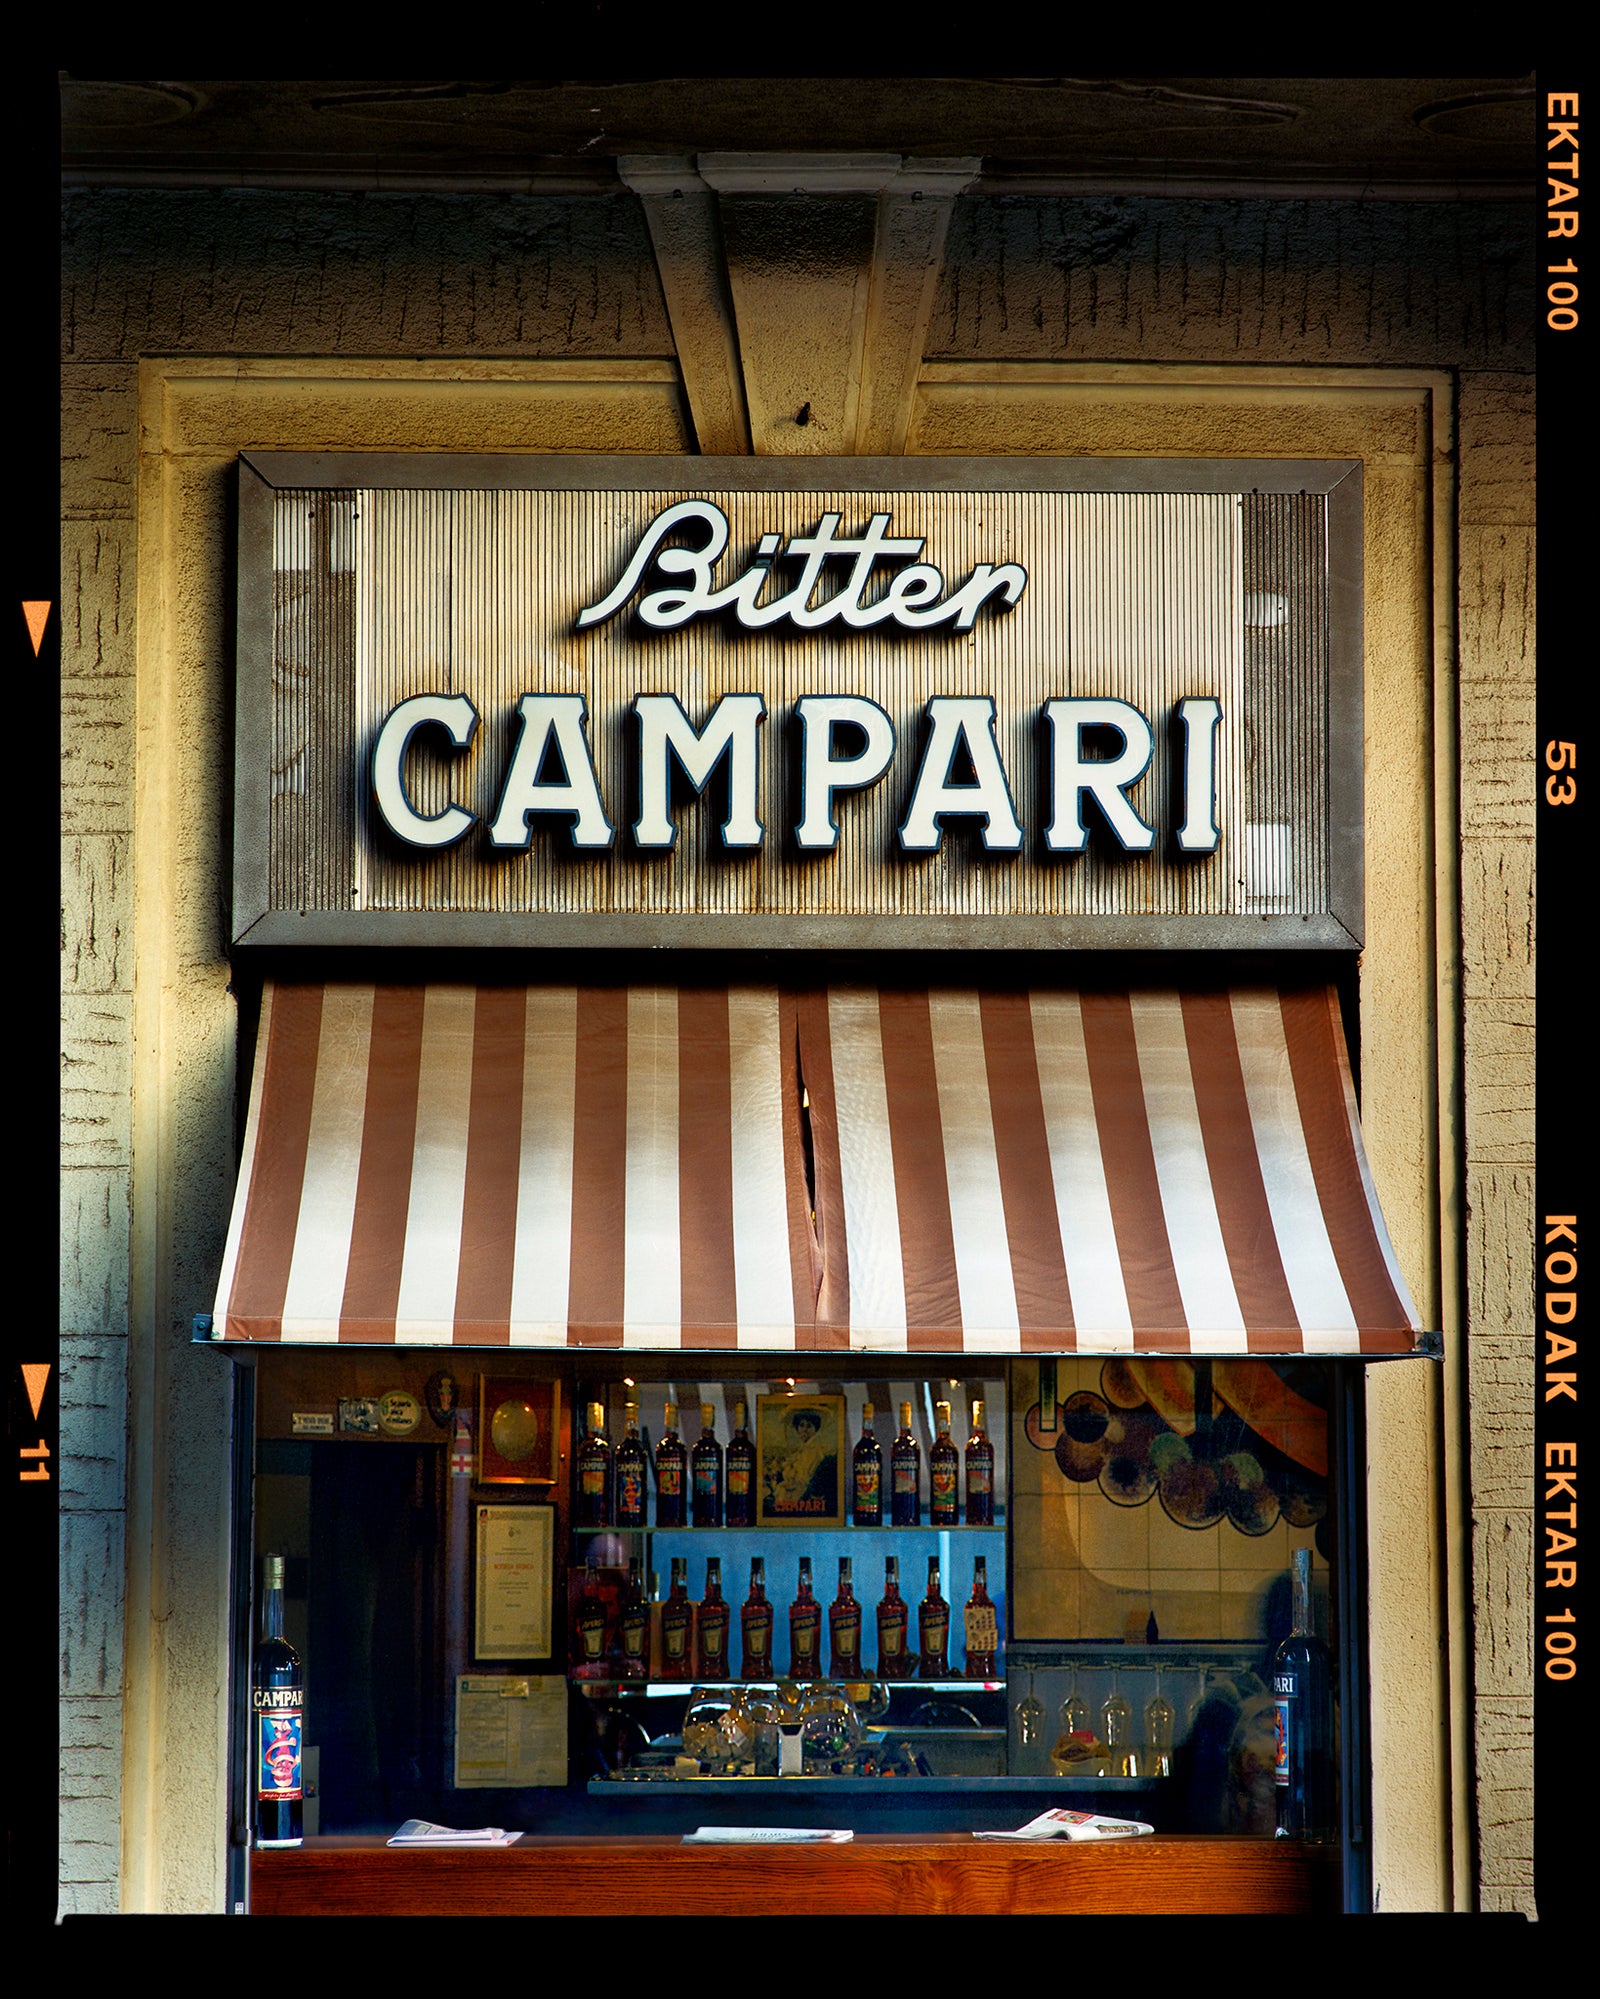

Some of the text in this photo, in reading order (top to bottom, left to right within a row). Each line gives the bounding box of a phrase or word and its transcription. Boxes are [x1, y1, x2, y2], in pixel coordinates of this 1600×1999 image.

[575, 498, 1028, 630] Bitter
[371, 692, 1223, 855] CAMPARI
[773, 1500, 827, 1512] CAMPARI
